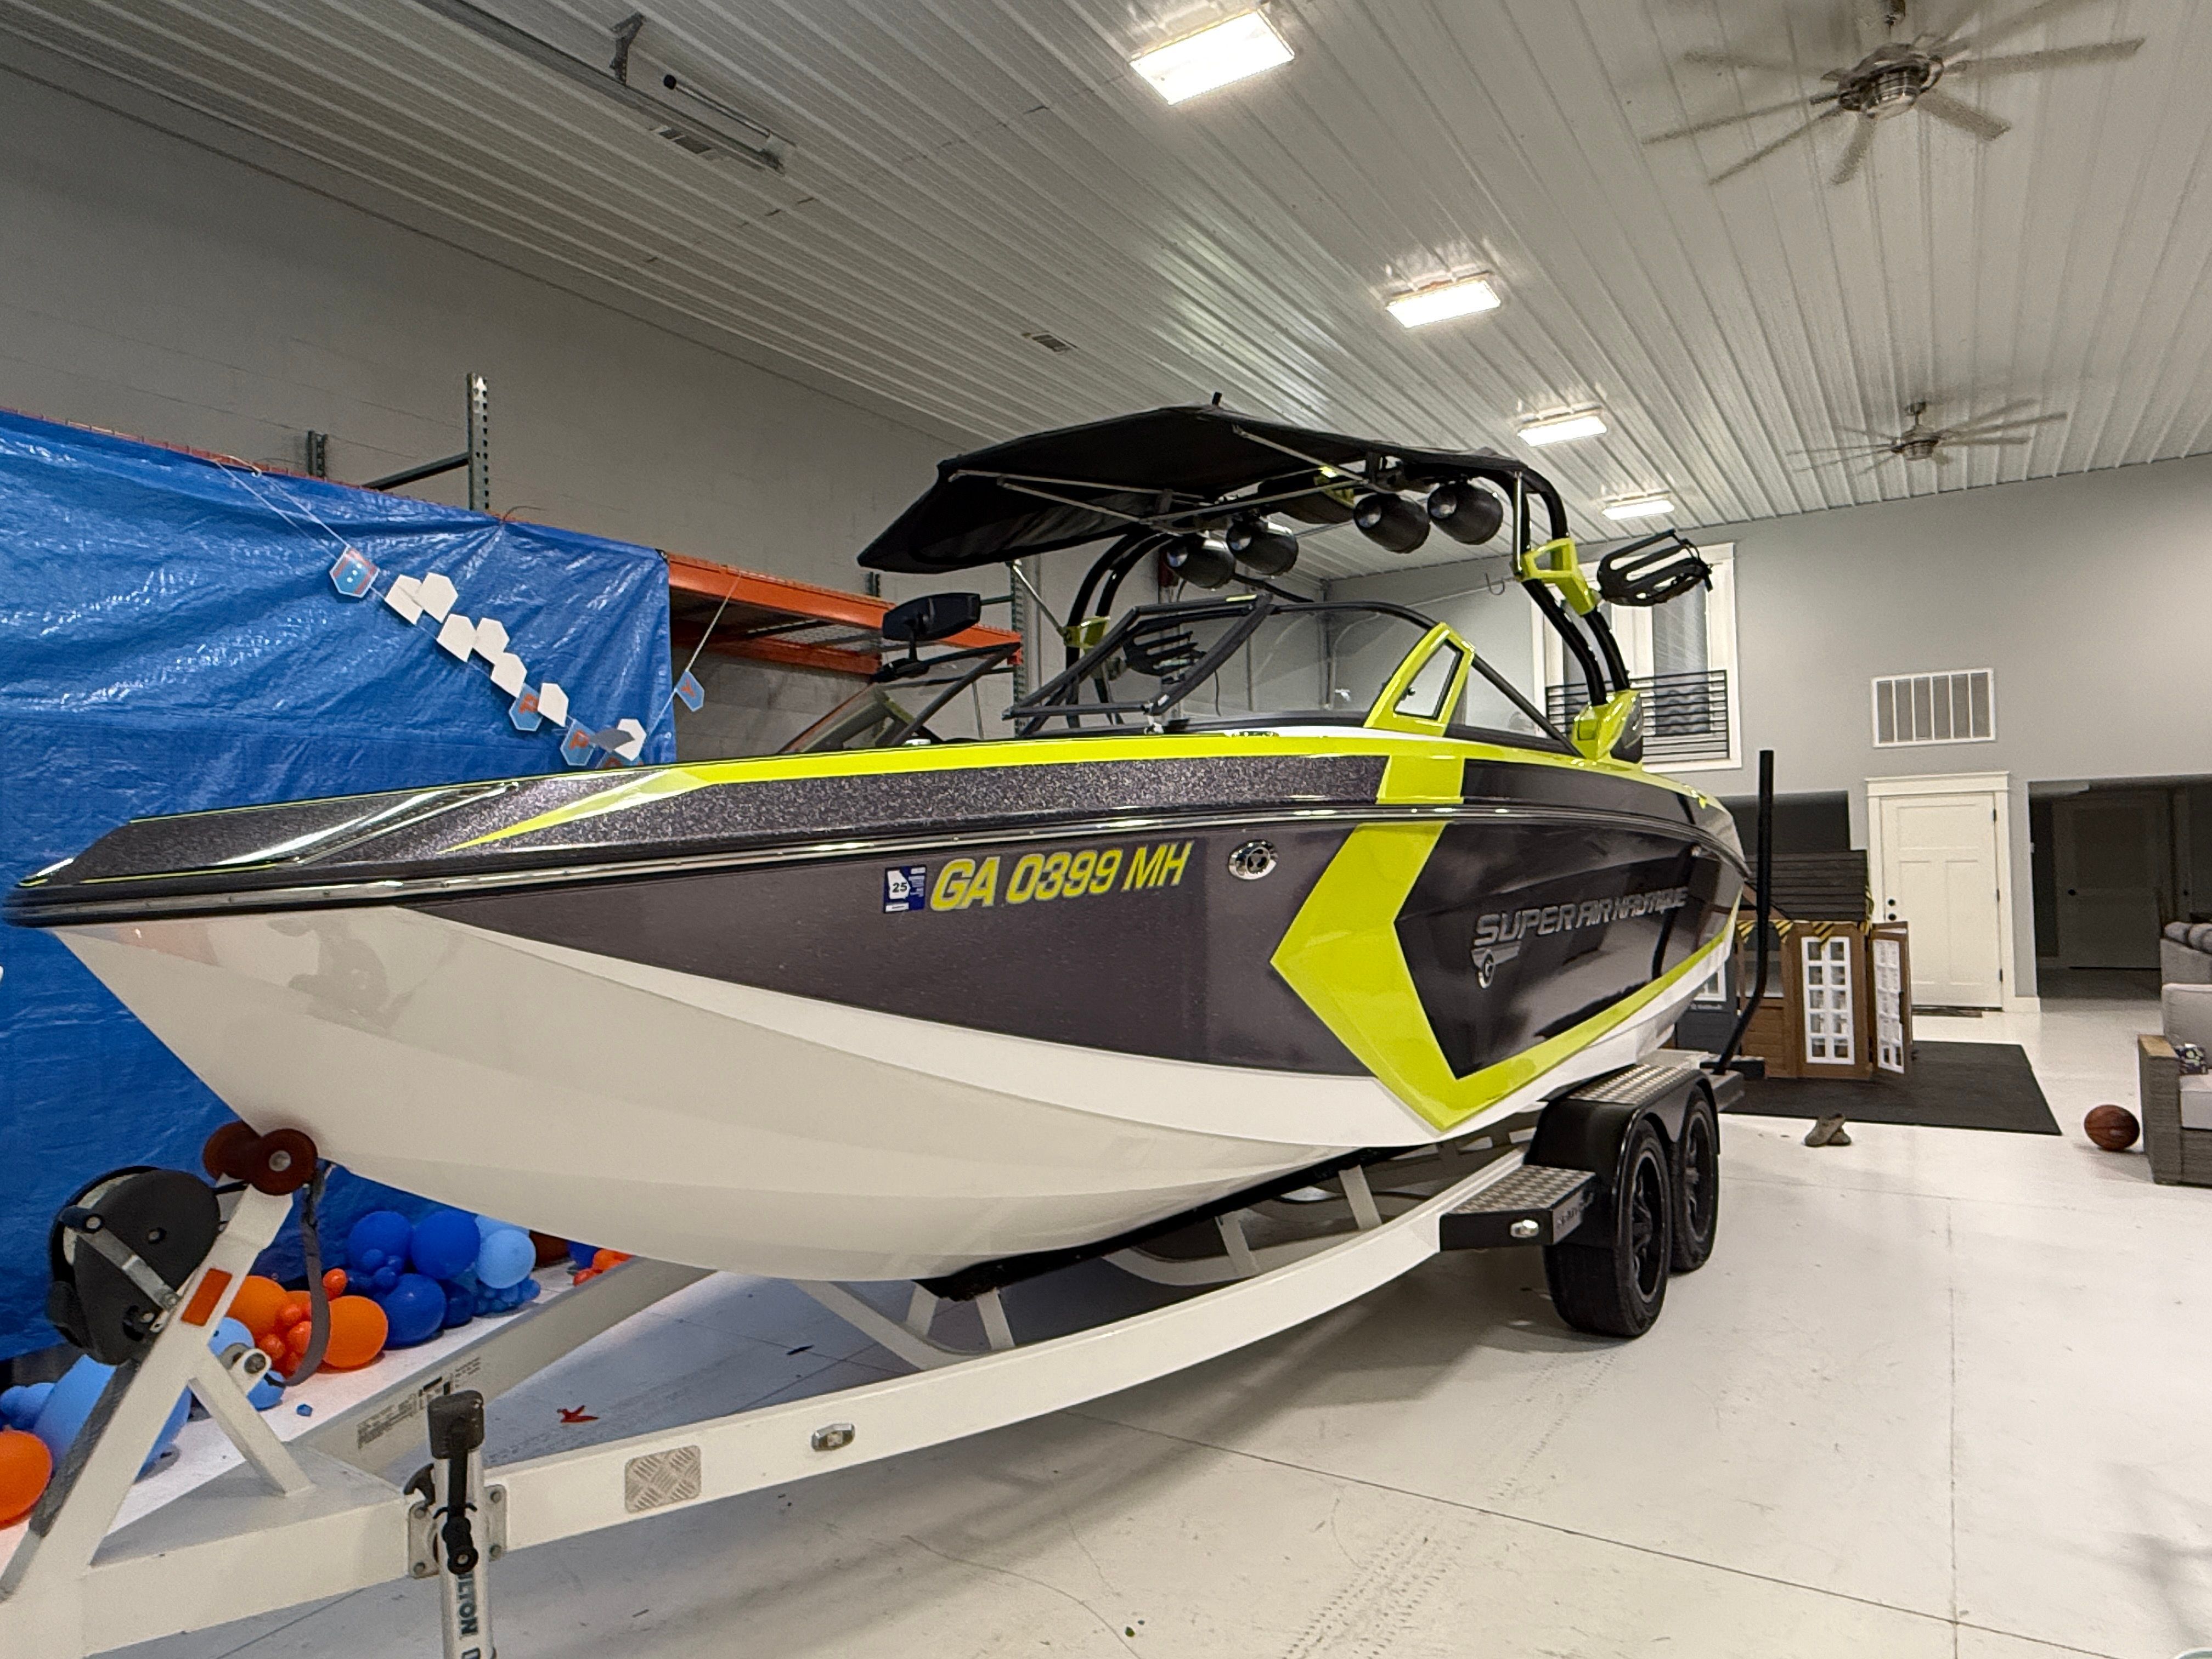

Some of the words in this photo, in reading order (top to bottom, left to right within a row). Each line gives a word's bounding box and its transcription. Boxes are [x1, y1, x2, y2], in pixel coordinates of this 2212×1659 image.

[892, 882, 907, 893] 25
[930, 856, 1001, 911] GA
[1006, 848, 1124, 904] 0399
[1120, 840, 1195, 892] MH
[1474, 903, 1576, 946] SUPER
[1575, 898, 1613, 928] AIR
